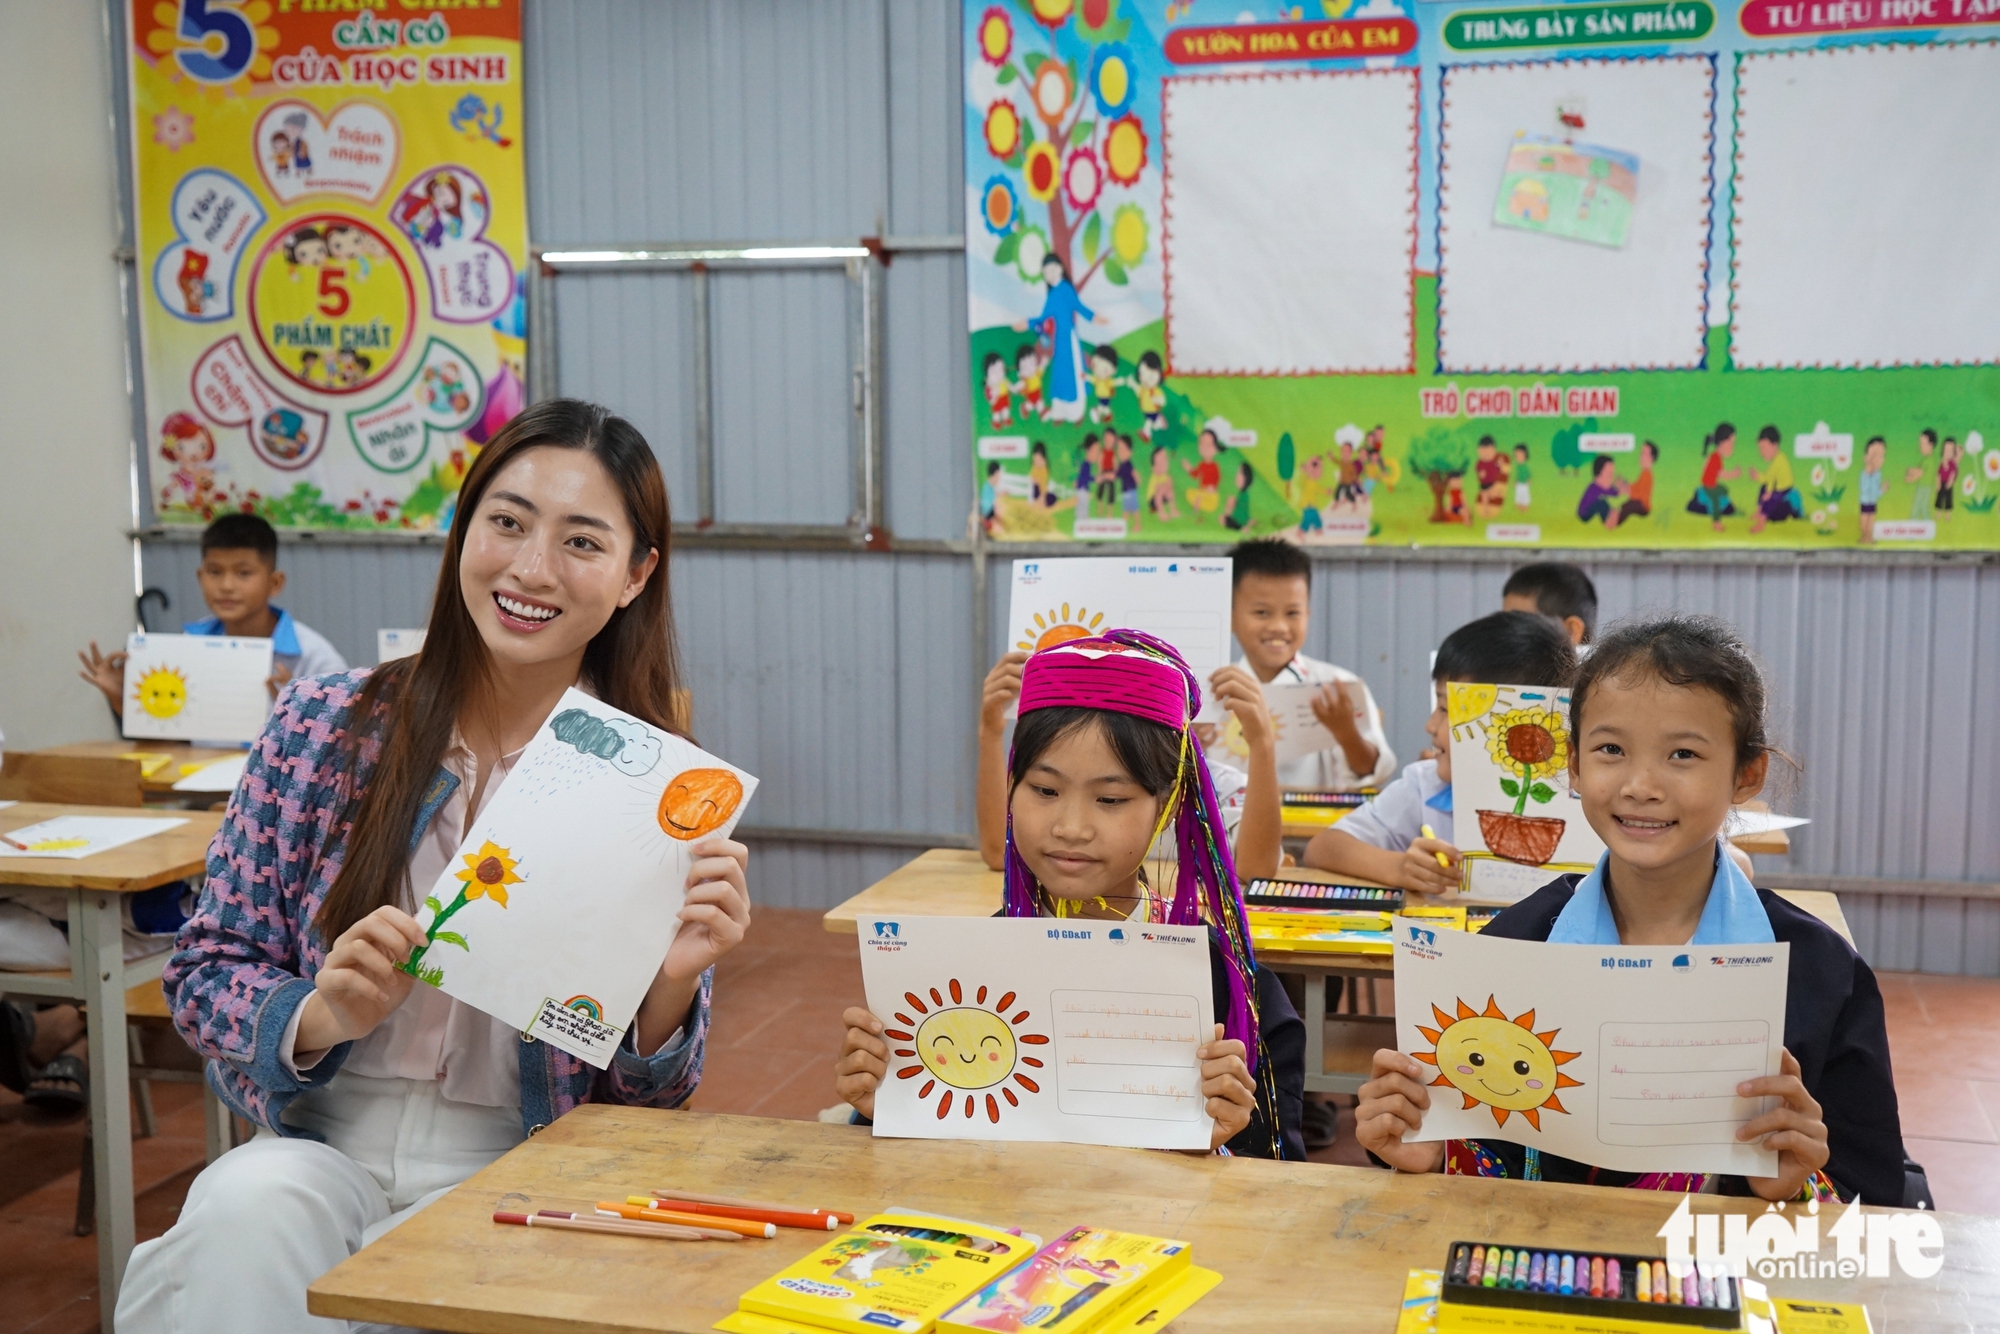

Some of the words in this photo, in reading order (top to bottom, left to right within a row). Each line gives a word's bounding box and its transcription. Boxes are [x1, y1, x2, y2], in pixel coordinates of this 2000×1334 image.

[1250, 31, 1300, 53] HOA
[1307, 25, 1355, 50] CỦA
[1361, 27, 1400, 49] EM
[277, 50, 342, 83] CỦA
[353, 57, 418, 89] HỌC
[428, 57, 506, 83] SINH
[319, 269, 350, 317] 5
[1421, 384, 1458, 414] TRÒ
[1465, 388, 1512, 414] CHƠI
[1518, 385, 1561, 414] DÂN
[1567, 388, 1617, 414] GIAN
[1047, 929, 1060, 940] BỘ
[1401, 942, 1417, 950] Chia
[1426, 949, 1443, 957] cùng
[1601, 957, 1615, 969] BỘ
[557, 1016, 569, 1025] em
[780, 1279, 852, 1298] COLORED
